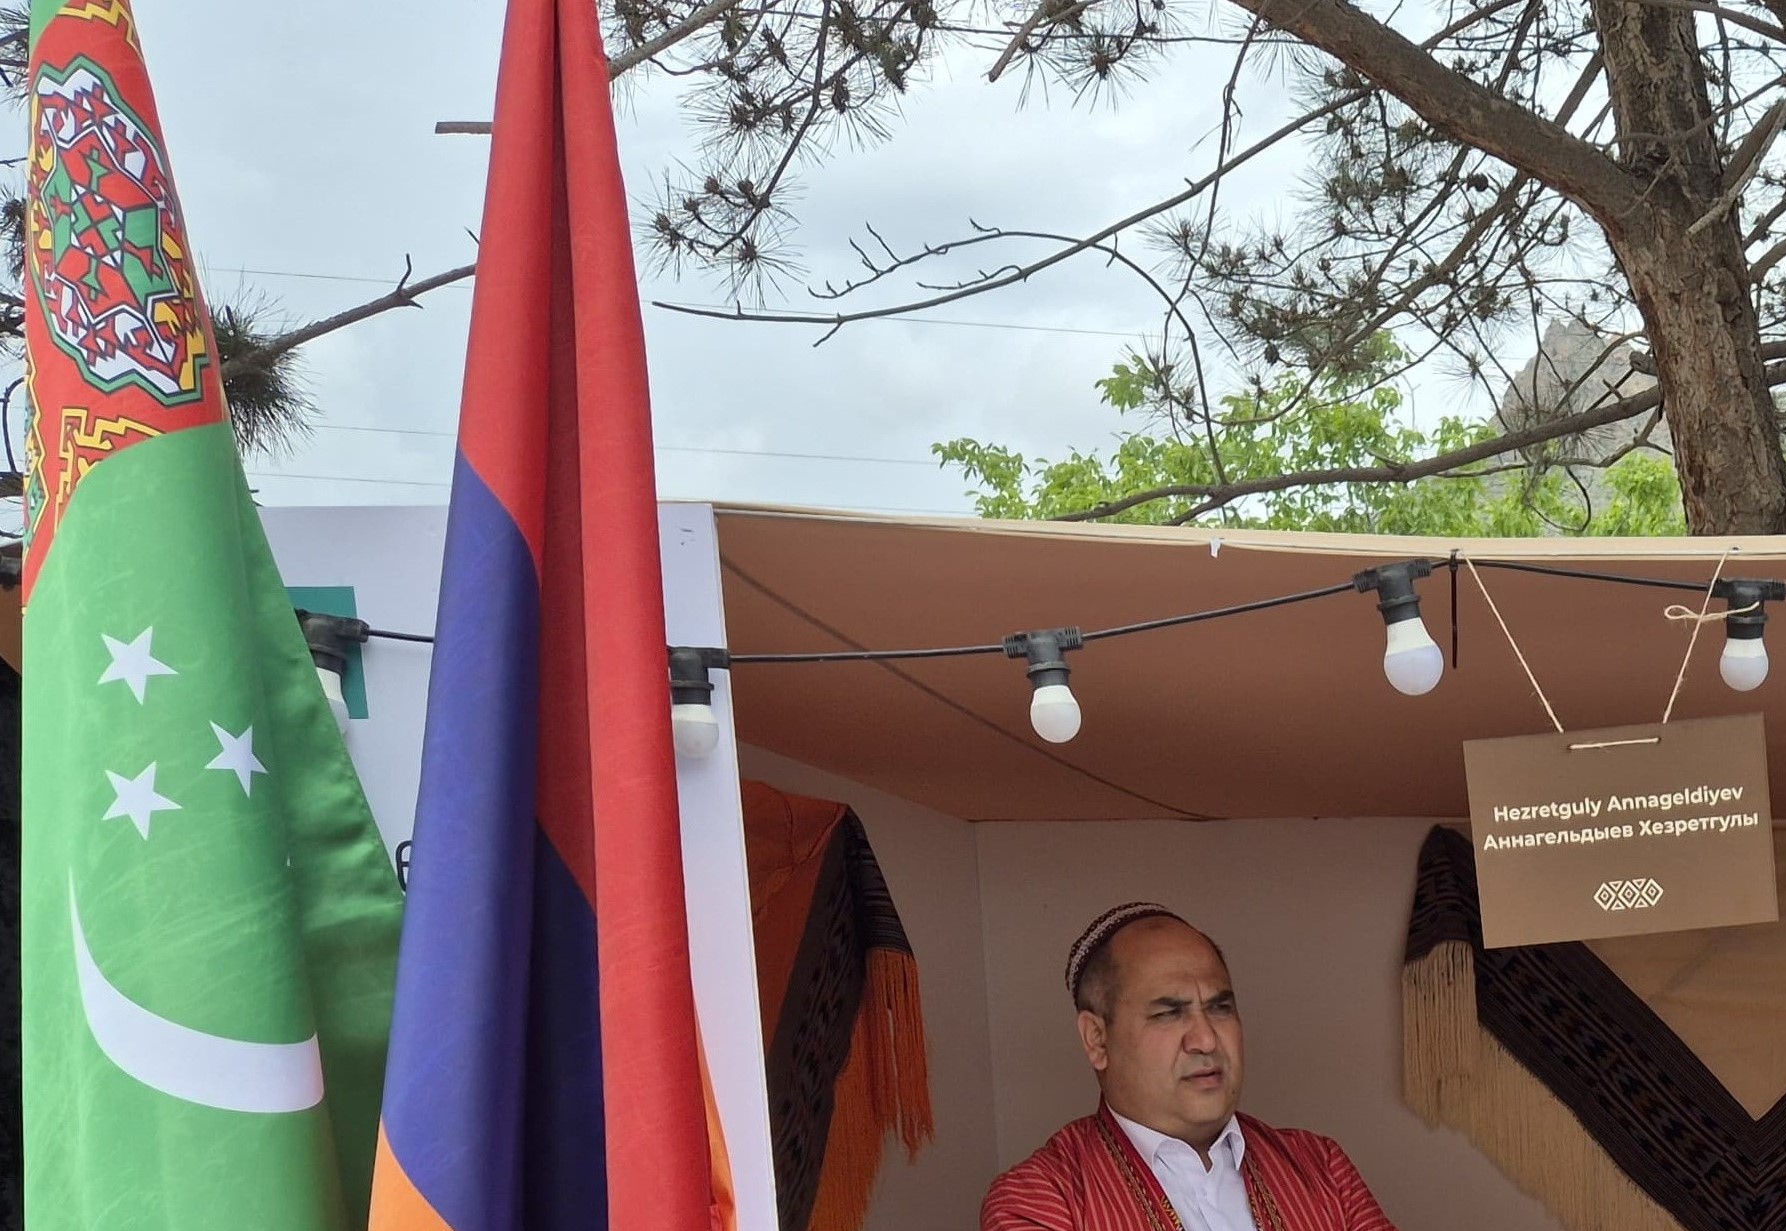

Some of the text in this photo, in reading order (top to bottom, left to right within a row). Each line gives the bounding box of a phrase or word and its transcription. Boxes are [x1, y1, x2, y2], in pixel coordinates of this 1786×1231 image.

[1493, 785, 1744, 823] Hezretguly Annageldiyev
[1483, 811, 1759, 851] Аннагельдыев Хезретгулы
